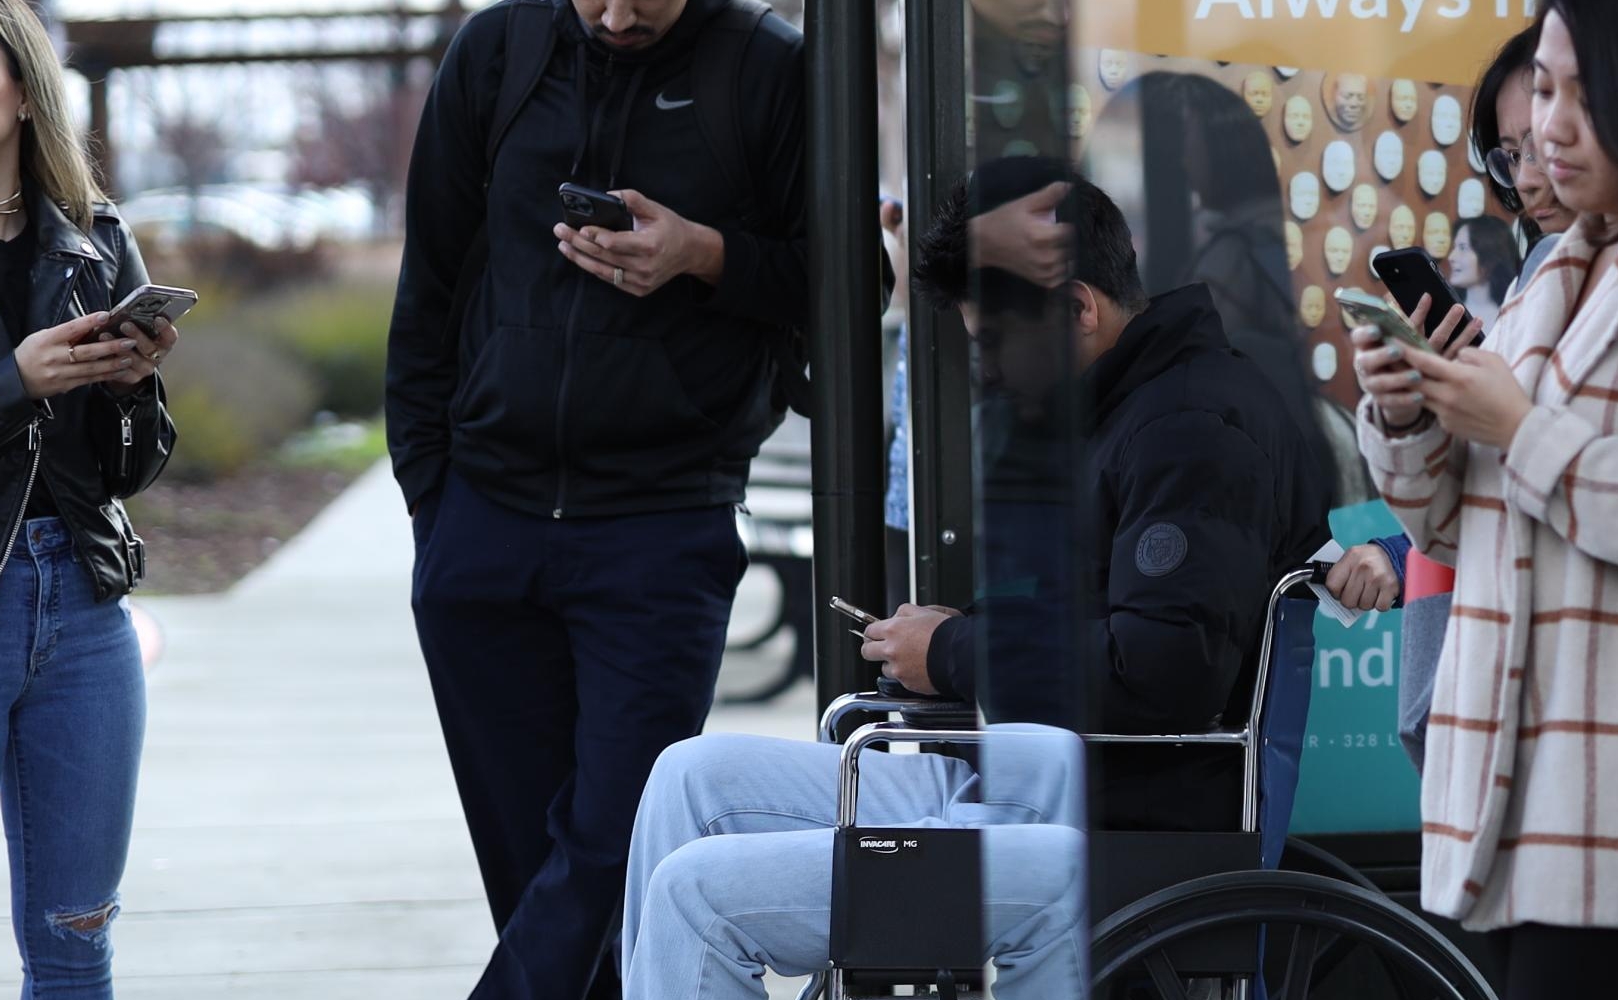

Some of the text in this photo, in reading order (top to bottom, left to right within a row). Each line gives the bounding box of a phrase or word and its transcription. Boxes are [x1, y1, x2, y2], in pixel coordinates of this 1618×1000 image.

[1343, 733, 1377, 747] 328
[860, 840, 918, 848] INVACARE MG
